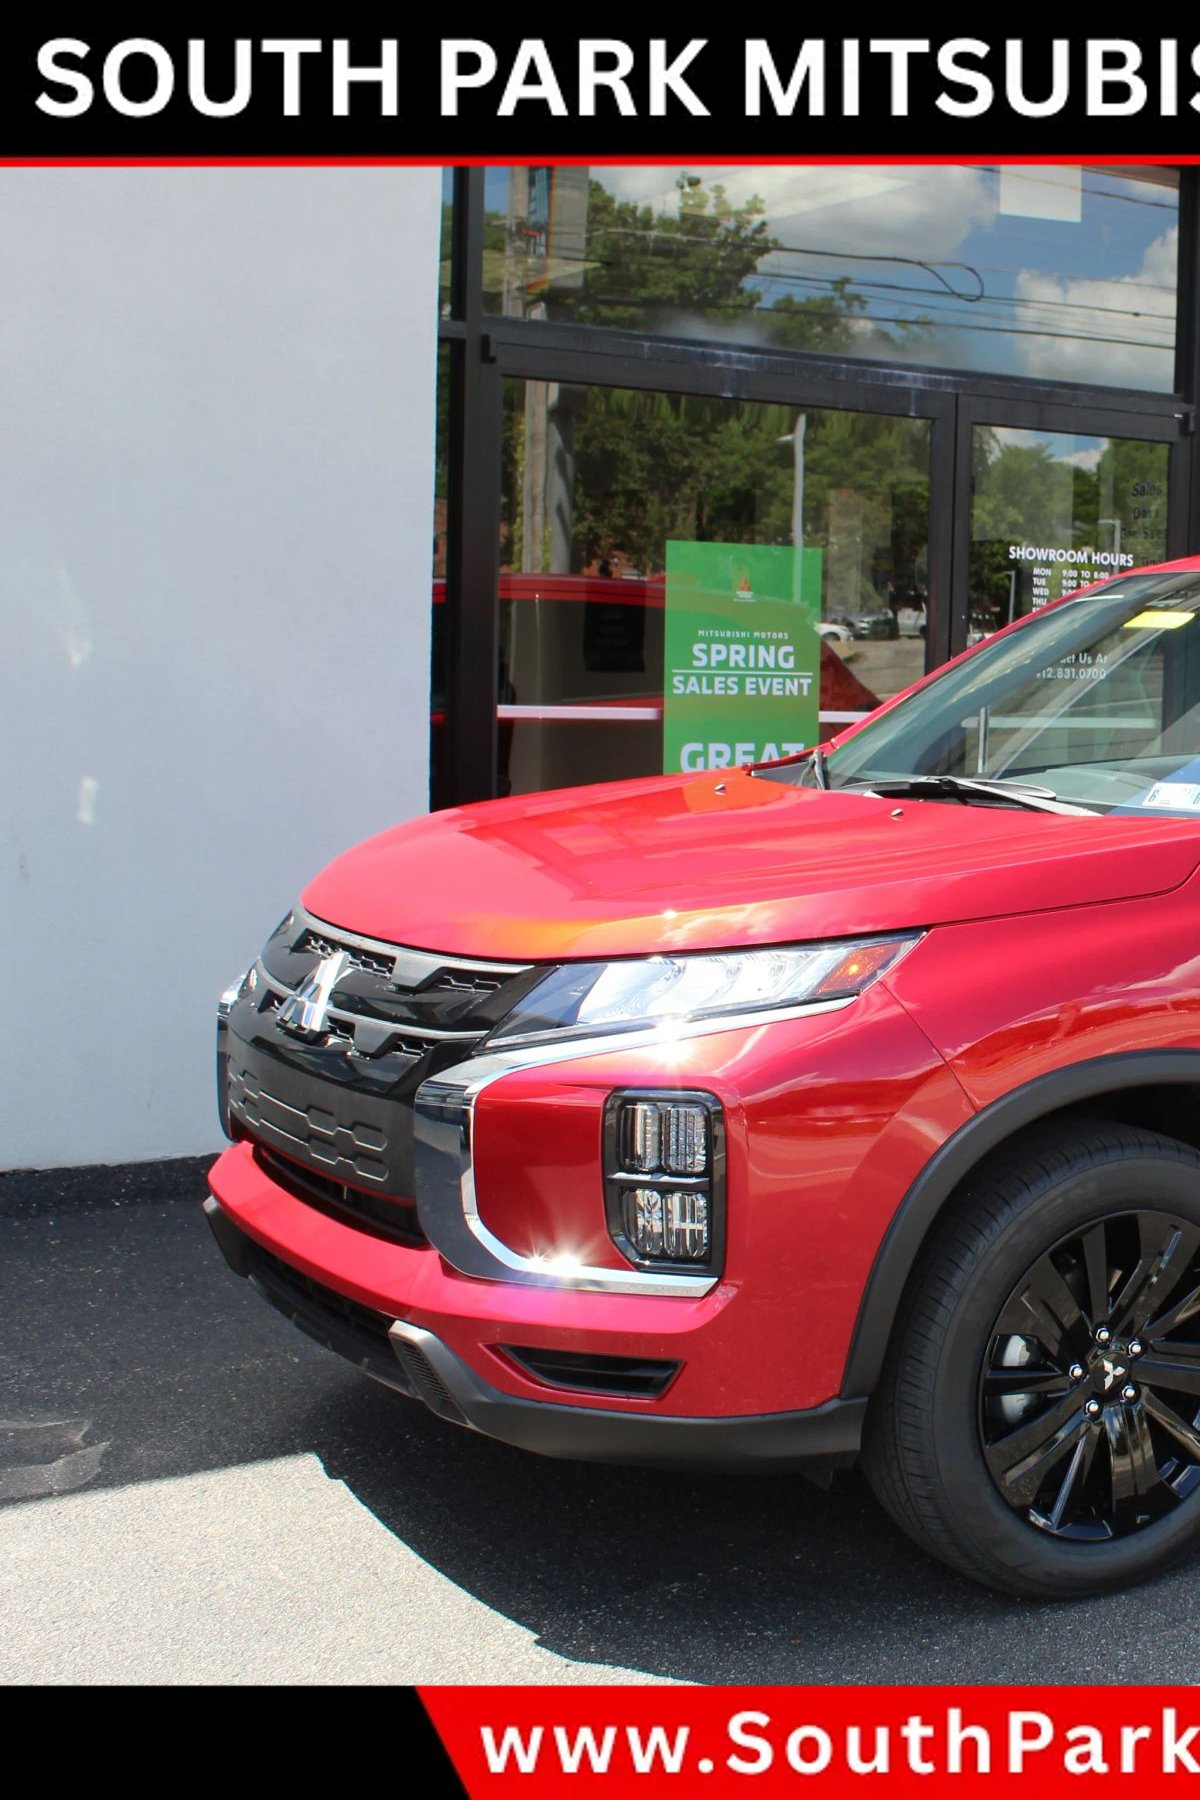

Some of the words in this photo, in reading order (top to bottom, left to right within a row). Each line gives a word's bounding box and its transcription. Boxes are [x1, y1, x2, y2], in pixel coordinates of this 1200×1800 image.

[1008, 546, 1088, 563] SHOWROOM
[1091, 551, 1134, 567] HOURS
[1032, 567, 1052, 576] MON
[1081, 570, 1091, 578] TO
[1032, 578, 1046, 586] TUE
[1032, 588, 1049, 596] WED
[1032, 597, 1047, 605] THU
[698, 630, 750, 639] MITSUBISHI
[753, 631, 789, 640] MOTORS
[692, 643, 795, 669] SPRING
[672, 675, 738, 695] SALES
[745, 677, 812, 697] EVENT
